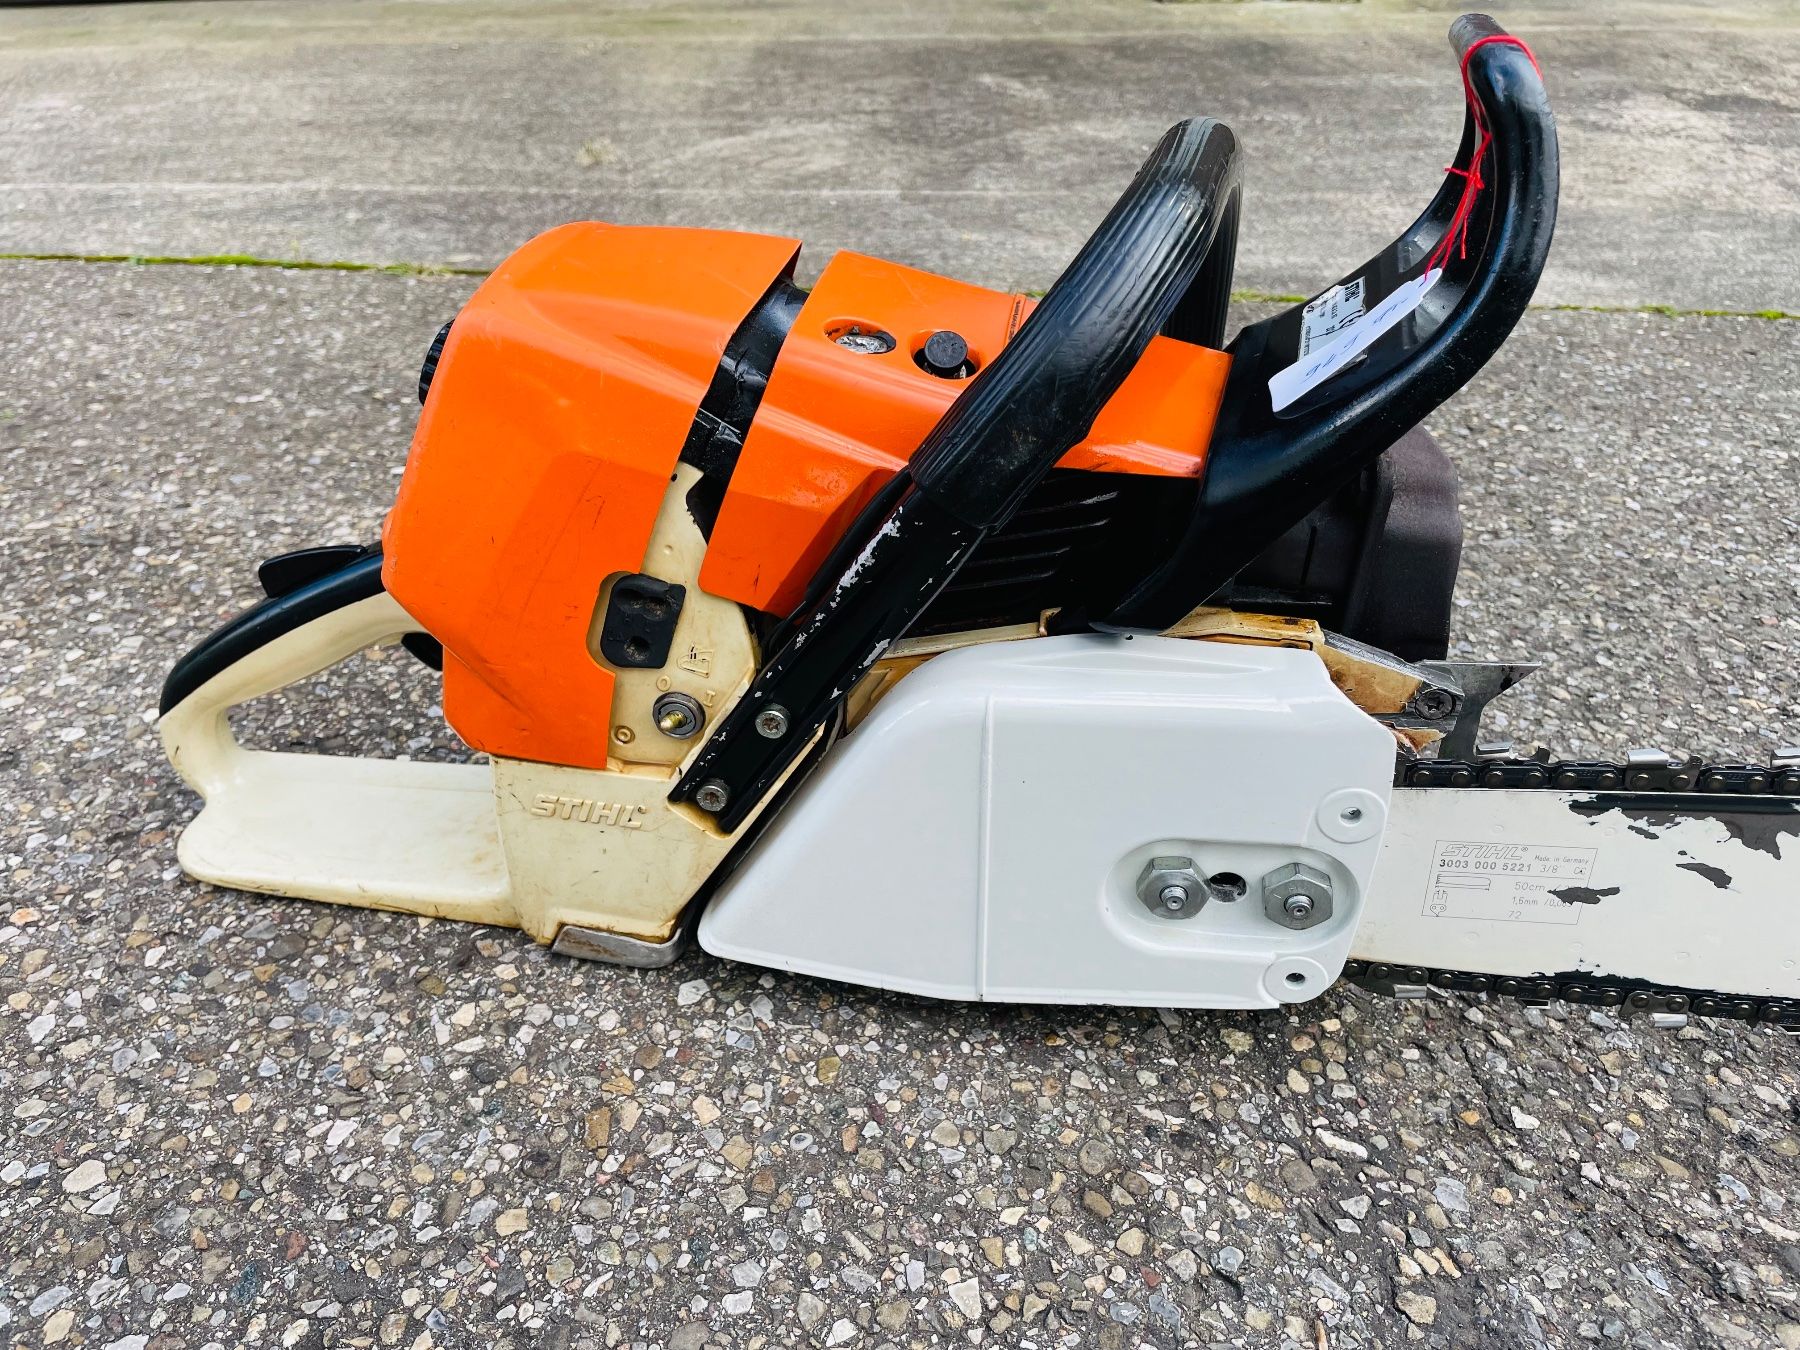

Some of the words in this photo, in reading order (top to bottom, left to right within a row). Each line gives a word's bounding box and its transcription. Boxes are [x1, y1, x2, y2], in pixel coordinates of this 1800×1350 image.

[531, 793, 643, 829] STIHL
[1440, 843, 1523, 861] STIHL
[1439, 859, 1469, 869] 3003
[1474, 861, 1497, 870] 000
[1502, 862, 1532, 872] 5221
[1562, 856, 1589, 865] Germany
[1514, 881, 1546, 891] 50cm
[1507, 910, 1522, 920] 72
